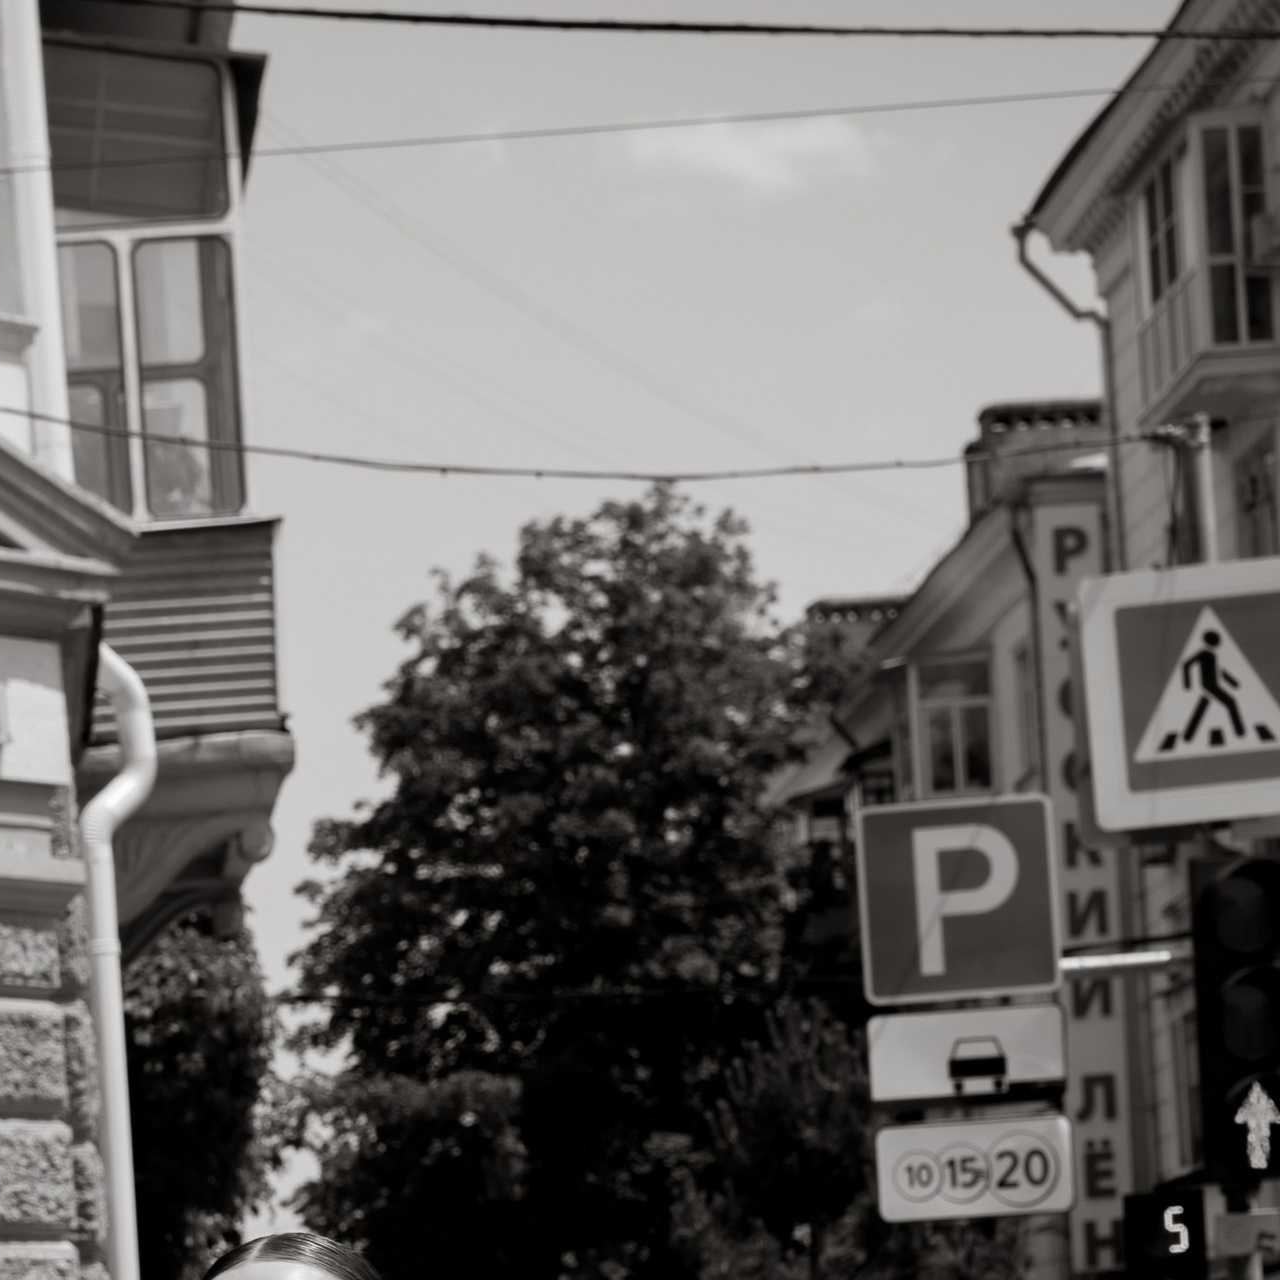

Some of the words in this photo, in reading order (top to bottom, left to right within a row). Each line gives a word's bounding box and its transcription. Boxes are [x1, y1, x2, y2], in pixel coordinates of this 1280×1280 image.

[912, 822, 1019, 976] P
[905, 1163, 934, 1189] 10
[946, 1156, 986, 1189] 15
[996, 1148, 1050, 1189] 20
[1163, 1205, 1190, 1253] 5
